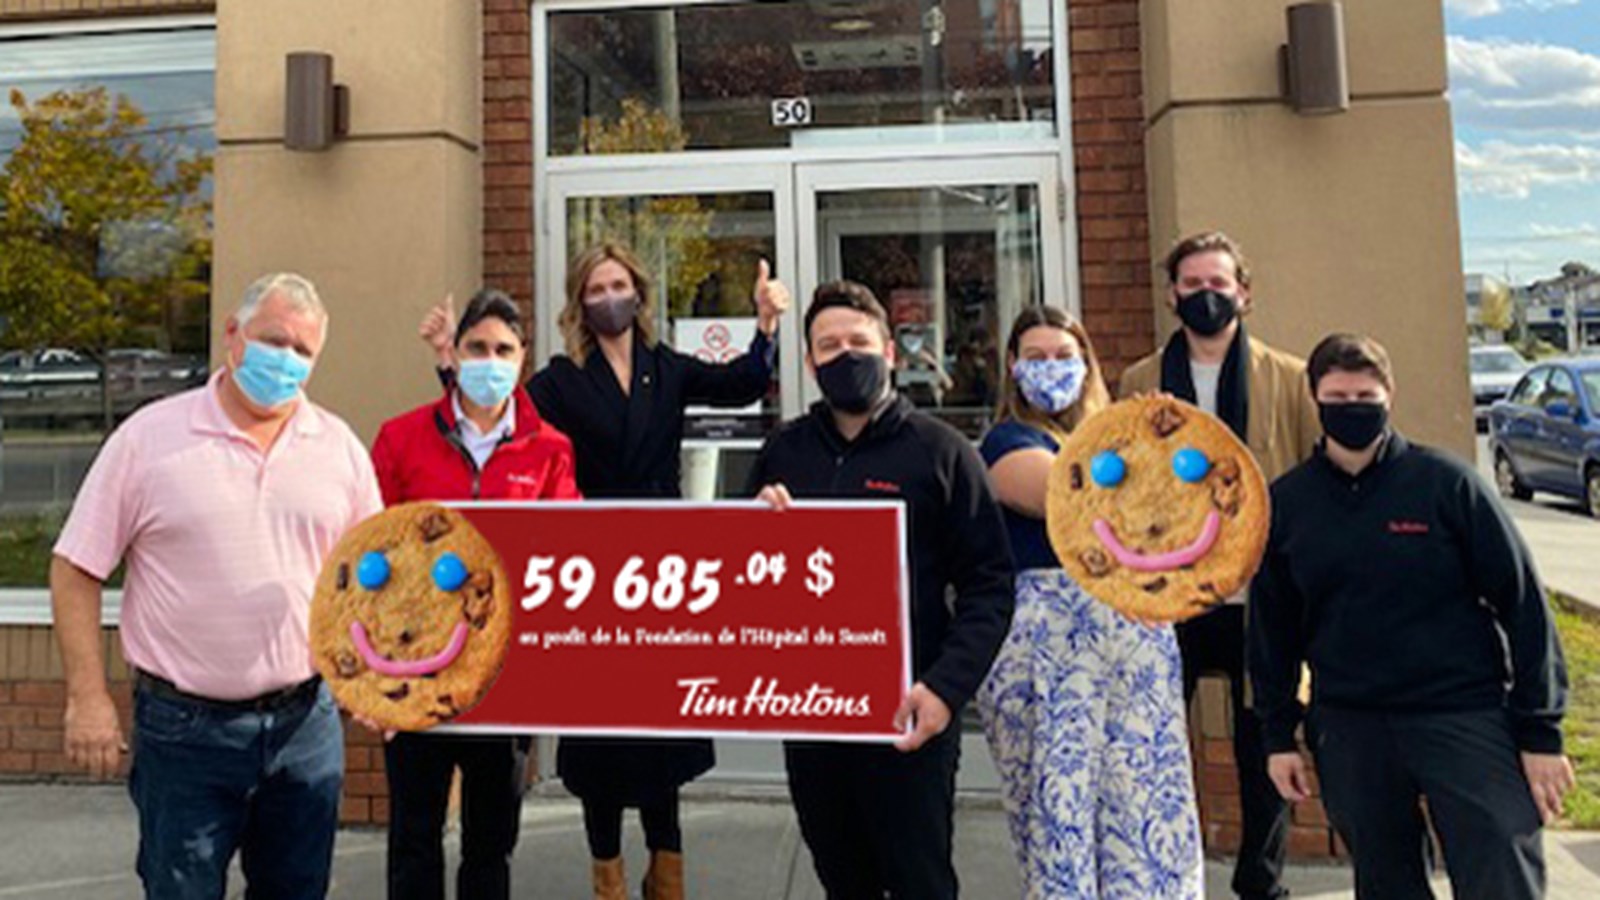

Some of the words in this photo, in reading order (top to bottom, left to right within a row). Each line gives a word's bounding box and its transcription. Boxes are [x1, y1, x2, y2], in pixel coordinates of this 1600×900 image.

[776, 100, 807, 123] 50
[520, 555, 596, 611] 59
[612, 554, 723, 614] 685
[804, 546, 835, 598] $
[591, 626, 612, 645] de
[615, 626, 631, 645] la
[717, 627, 736, 645] de
[677, 677, 738, 716] Tim
[742, 676, 871, 717] Hortons
